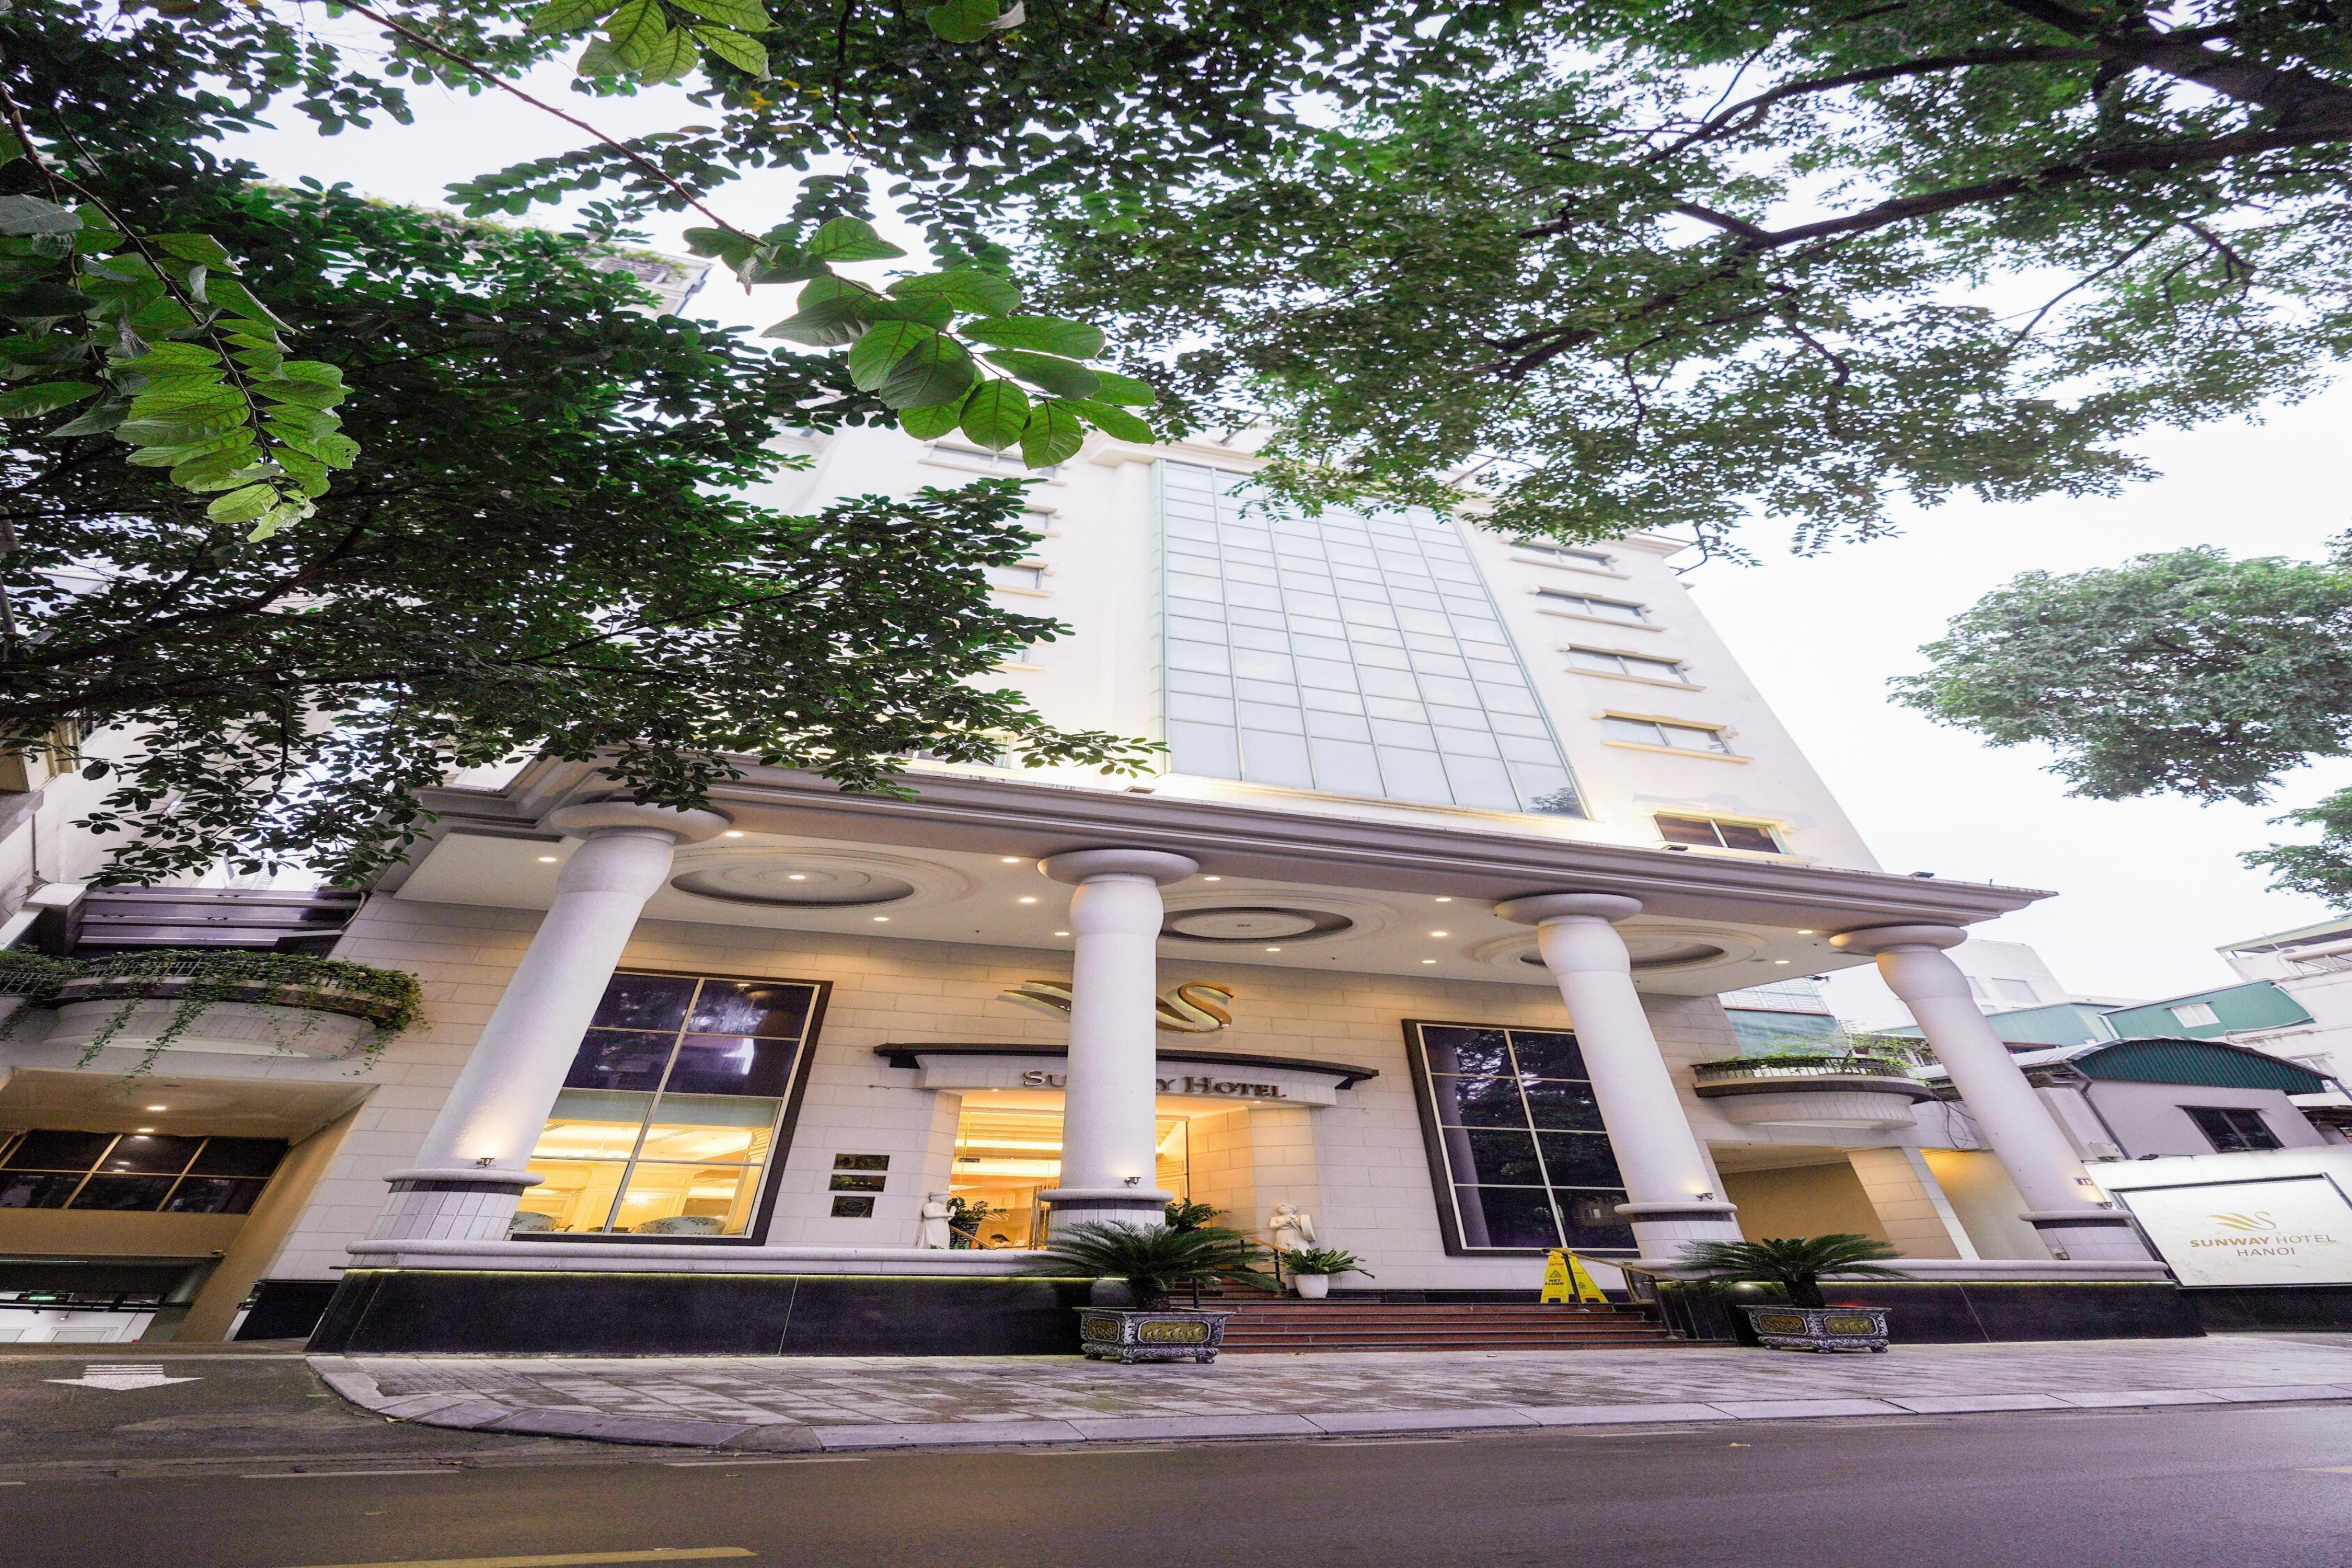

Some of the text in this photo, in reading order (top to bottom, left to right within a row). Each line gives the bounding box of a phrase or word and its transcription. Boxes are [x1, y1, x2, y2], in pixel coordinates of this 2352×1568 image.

[1023, 1070, 1287, 1098] SUY HOTEL
[2190, 1234, 2337, 1247] SUNWAY HOTEL
[2237, 1247, 2295, 1256] HANOI
